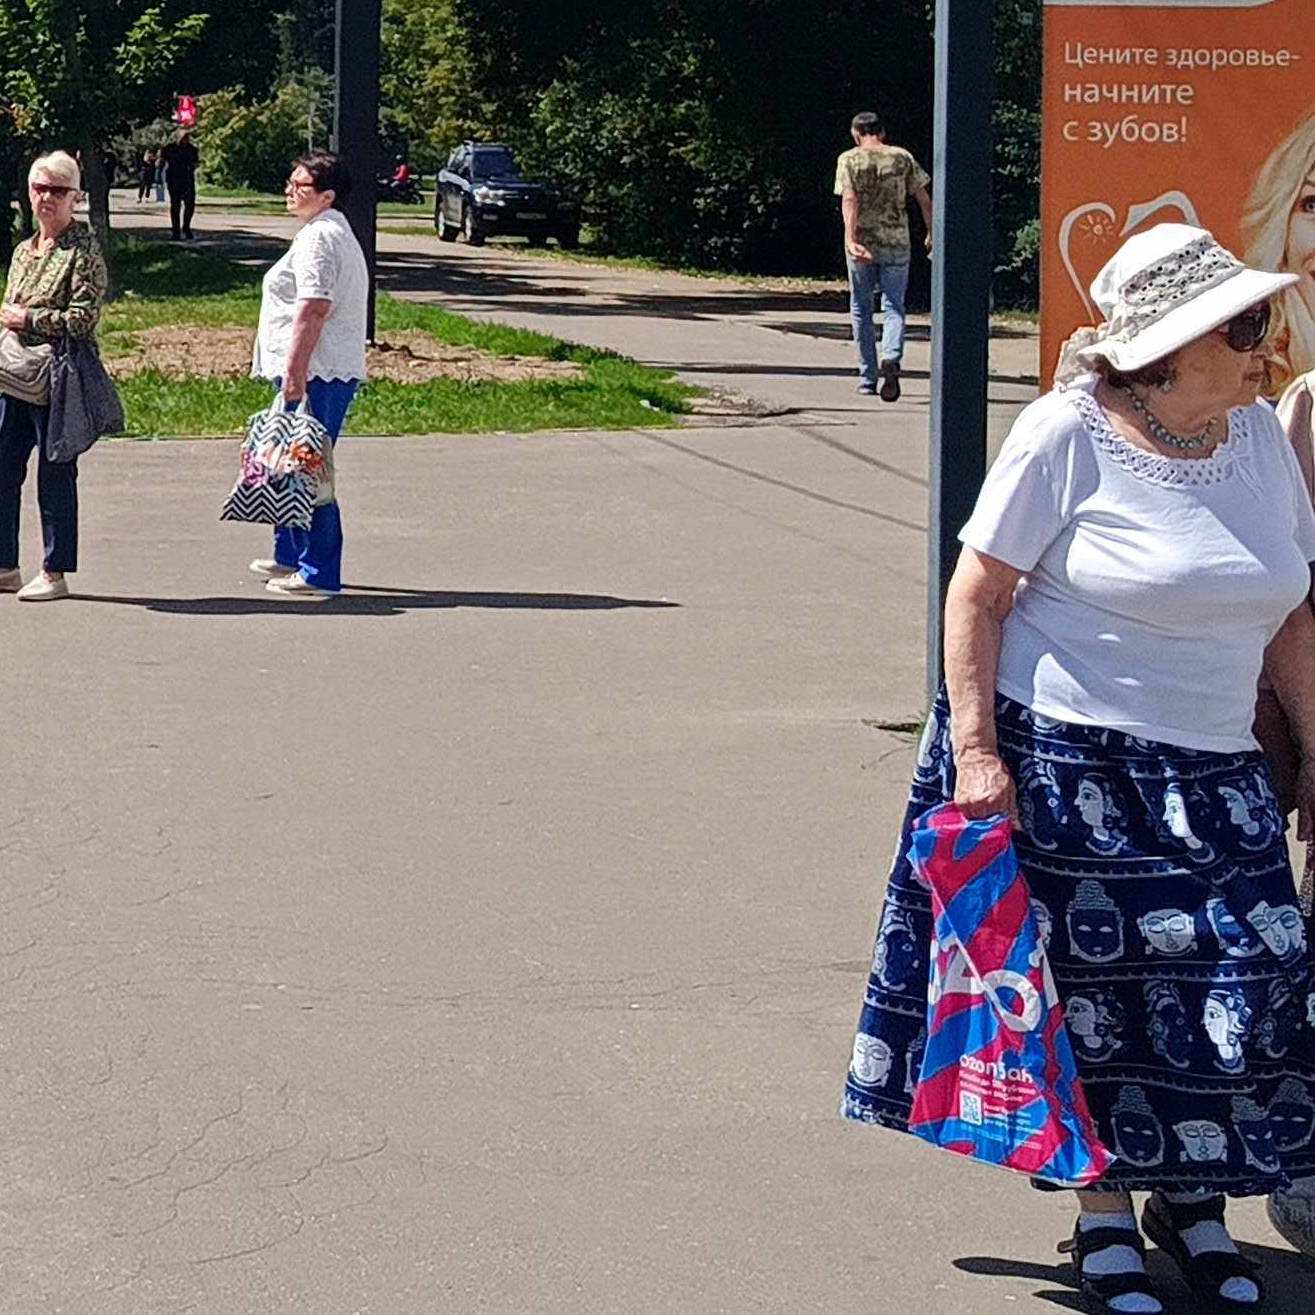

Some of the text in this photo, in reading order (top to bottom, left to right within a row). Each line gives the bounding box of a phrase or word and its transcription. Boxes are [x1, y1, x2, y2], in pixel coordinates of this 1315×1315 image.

[1064, 42, 1301, 70] Цените здоровье-
[1063, 83, 1194, 104] начните
[1063, 115, 1187, 149] с зубов!
